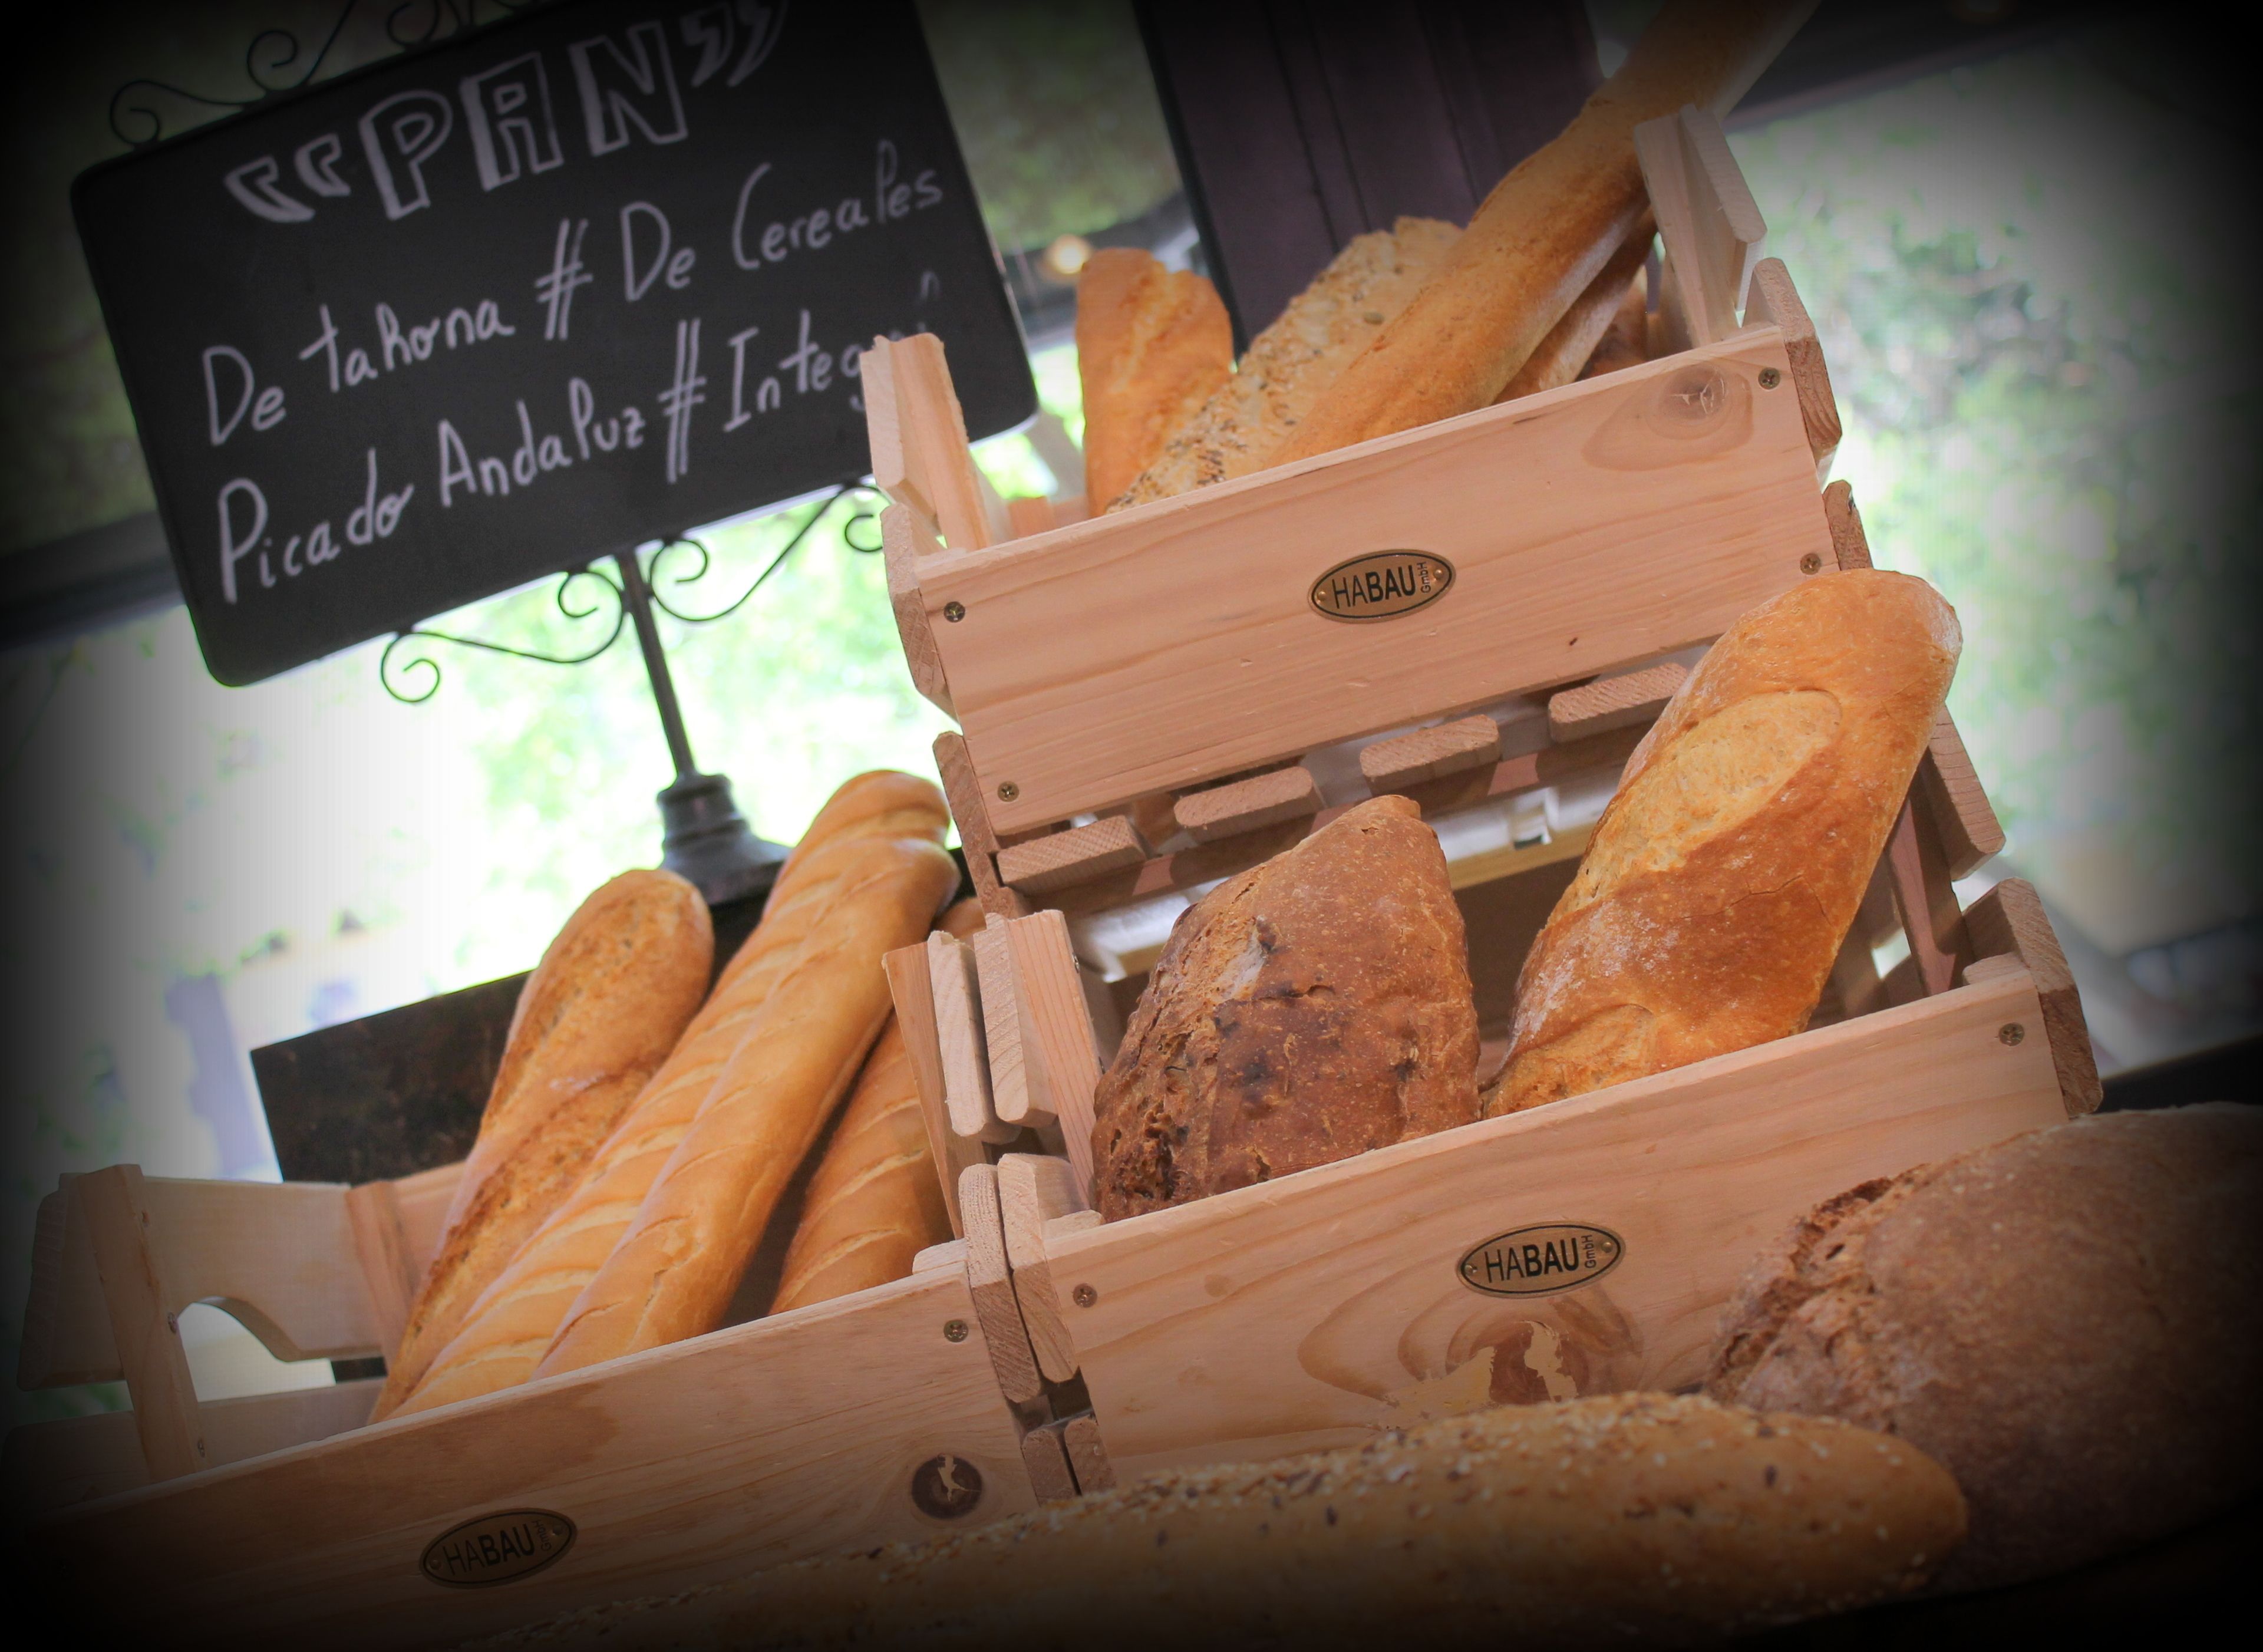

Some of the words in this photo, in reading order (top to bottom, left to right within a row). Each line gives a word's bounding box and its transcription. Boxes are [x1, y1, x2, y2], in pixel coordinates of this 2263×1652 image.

[203, 345, 286, 446] De
[299, 299, 516, 393] tahona
[621, 202, 696, 301] De
[732, 139, 942, 270] Cereales
[217, 447, 415, 604] Picado
[438, 377, 646, 507] Andaluz
[1332, 565, 1416, 609] HABAU
[1416, 561, 1431, 593] GmbH
[1484, 1238, 1579, 1283] HABAU
[1581, 1235, 1596, 1268] GmbH
[443, 1524, 535, 1575] HABAU
[532, 1519, 552, 1552] GmbH
